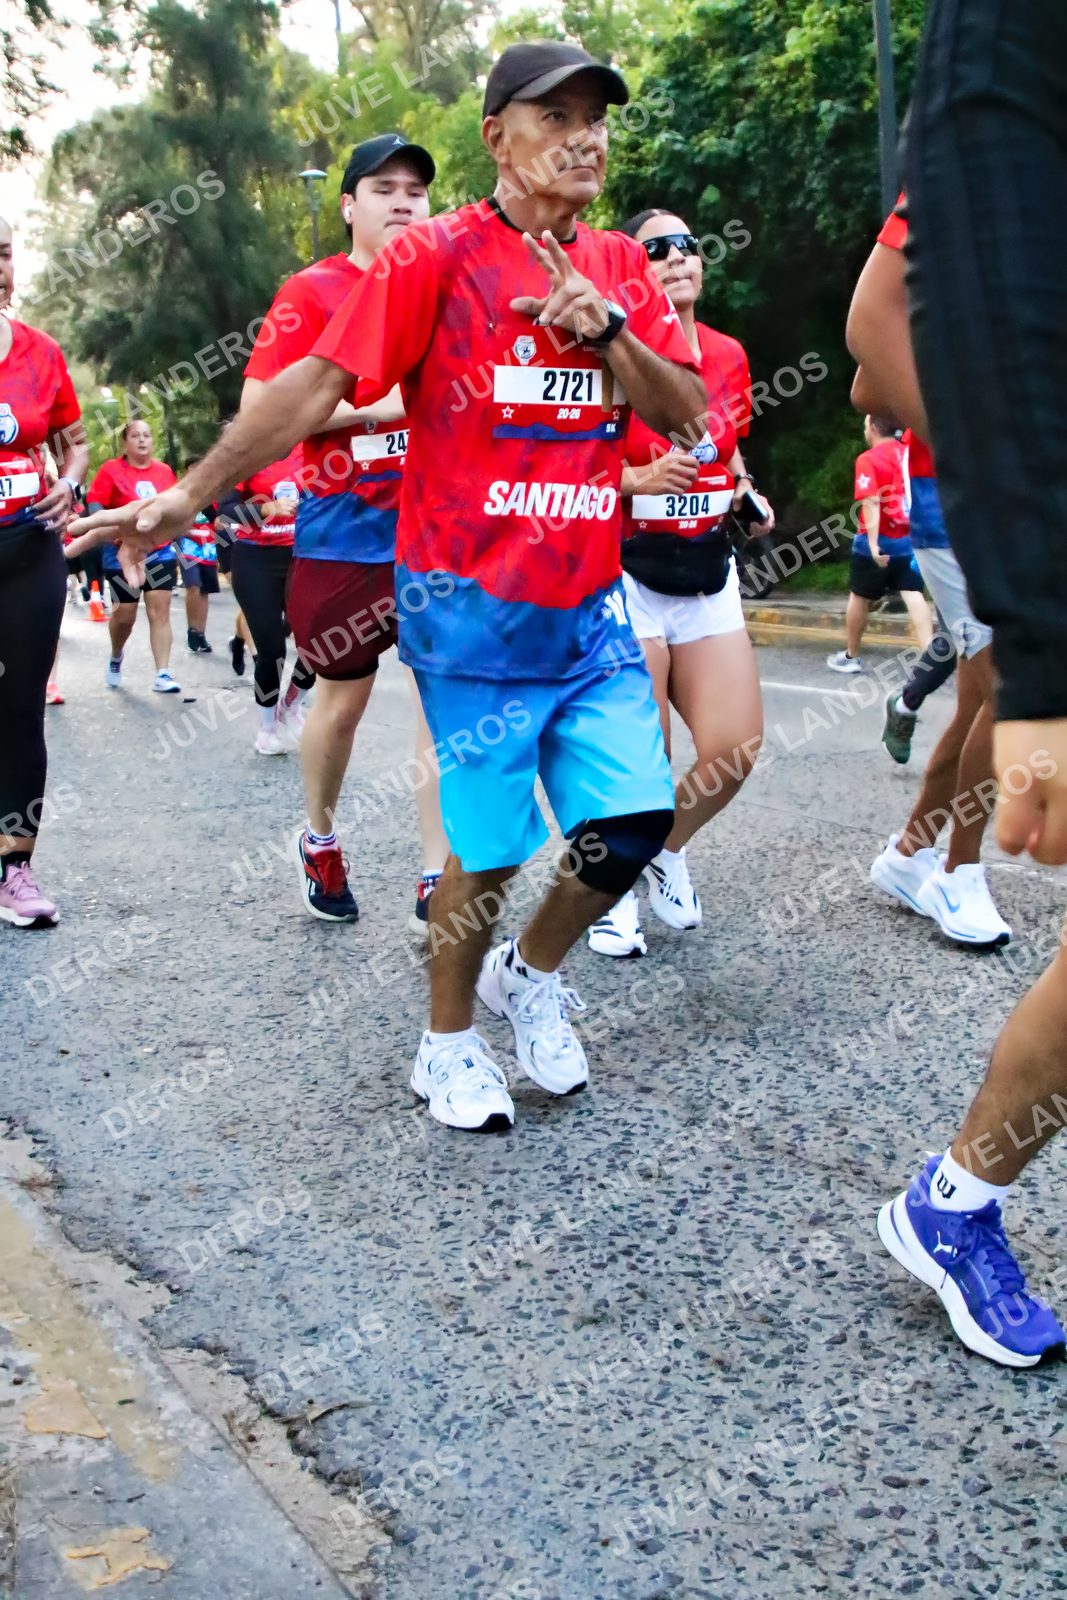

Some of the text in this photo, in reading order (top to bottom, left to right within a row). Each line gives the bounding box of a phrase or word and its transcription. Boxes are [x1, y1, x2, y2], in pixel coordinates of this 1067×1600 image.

[543, 370, 594, 402] 2721
[385, 430, 409, 455] 24
[483, 480, 616, 520] SANTIAGO
[665, 495, 710, 517] 3204
